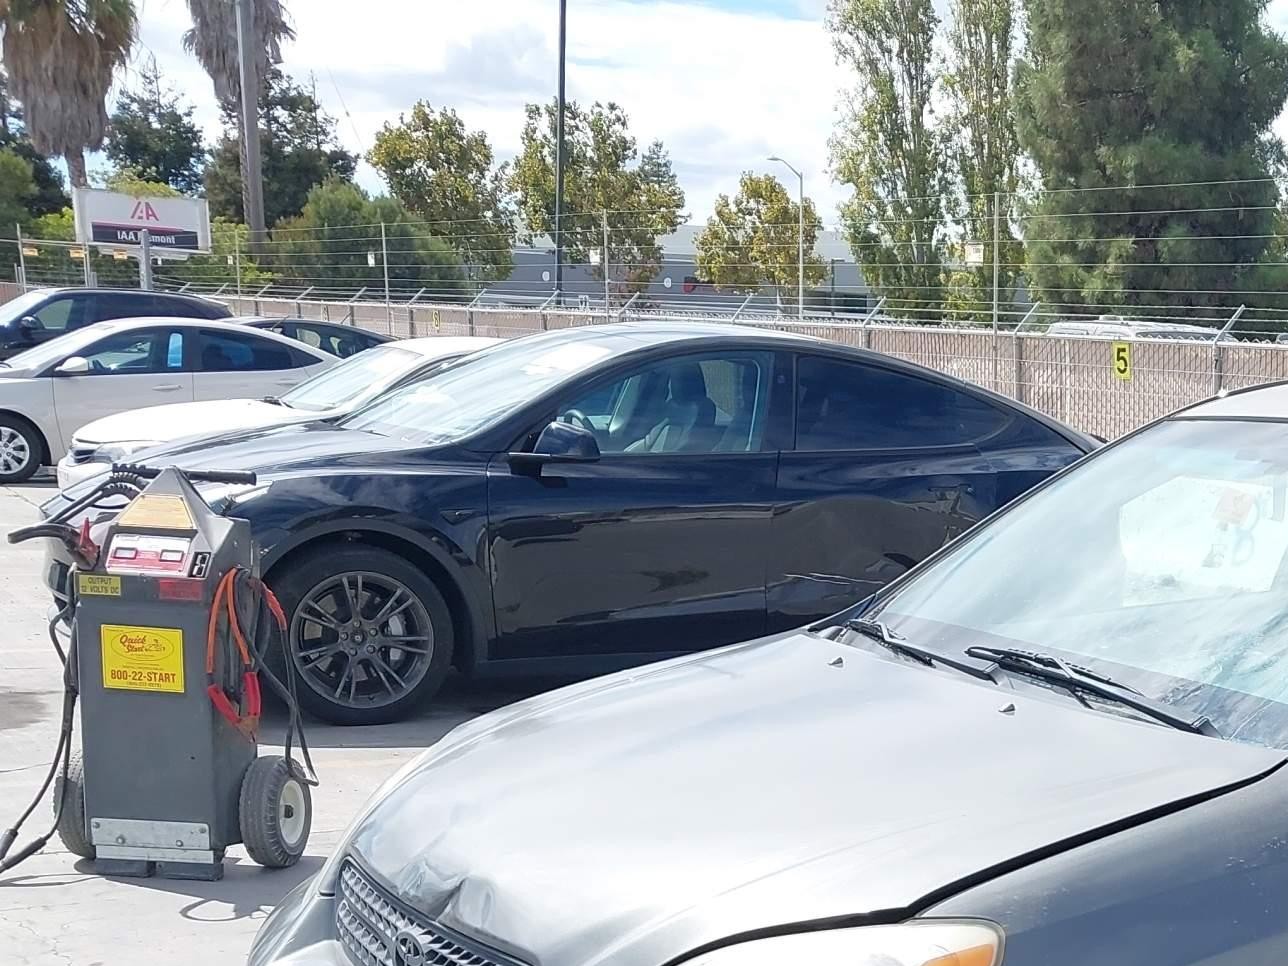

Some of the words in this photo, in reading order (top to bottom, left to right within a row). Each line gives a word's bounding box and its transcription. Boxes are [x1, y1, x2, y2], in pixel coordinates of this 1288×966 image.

[117, 230, 136, 241] IAA
[1117, 347, 1128, 374] 5
[87, 577, 112, 585] OUTPUT
[120, 634, 147, 647] Quick
[111, 669, 177, 683] 800-22-START
